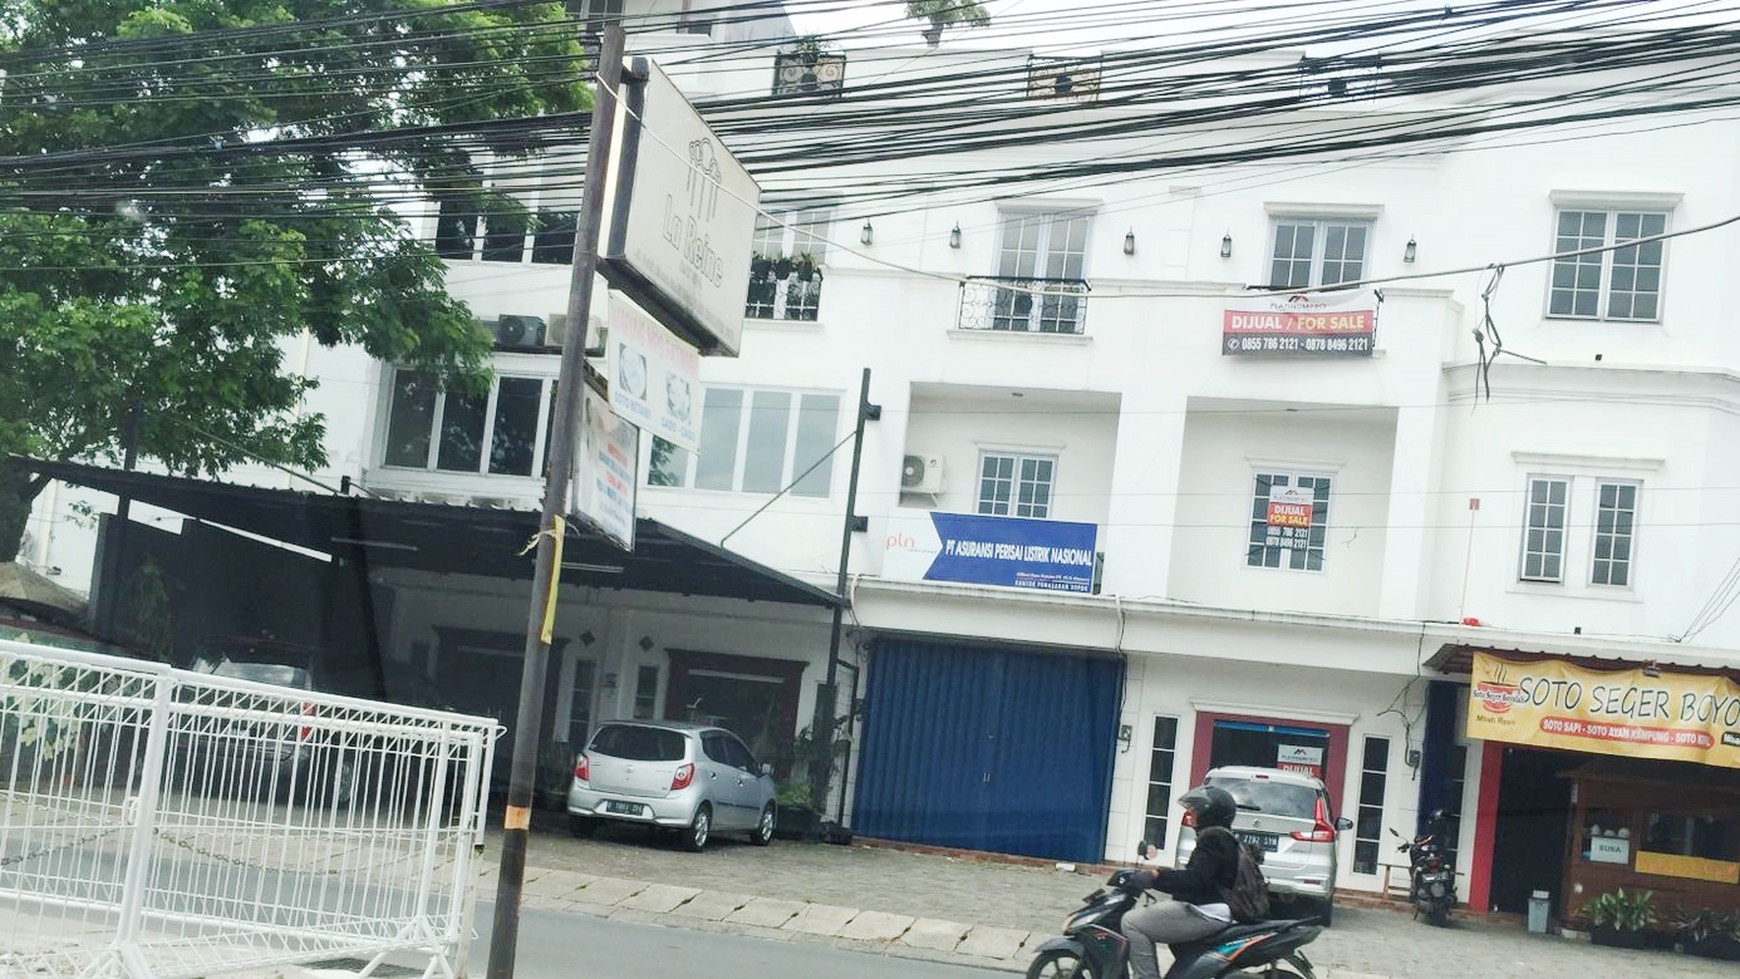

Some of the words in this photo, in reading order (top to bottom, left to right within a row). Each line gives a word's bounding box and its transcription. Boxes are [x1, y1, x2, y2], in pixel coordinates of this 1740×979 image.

[663, 193, 683, 251] La
[684, 214, 723, 289] Reine
[1231, 315, 1283, 330] DIJUAL
[1286, 317, 1293, 330] /
[1297, 316, 1326, 330] FOR
[1329, 315, 1365, 330] SALE
[1279, 337, 1299, 351] 2121
[1348, 338, 1368, 351] 2121
[1274, 505, 1305, 516] DIJUAL
[1270, 514, 1287, 524] FOR
[1288, 516, 1309, 526] SALE
[886, 532, 916, 550] pln
[945, 539, 956, 556] PT
[956, 541, 994, 559] ASURANSI
[994, 544, 1024, 561] PERISAI
[1024, 547, 1049, 563] LISTRIK
[1050, 549, 1092, 566] NASIONAL
[1519, 677, 1582, 710] SOTO
[1590, 686, 1671, 720] SEGER
[1543, 719, 1562, 731] SOTO
[1564, 721, 1582, 733] SAPI
[1586, 723, 1606, 736] SOTO
[1608, 725, 1630, 739] AYAM
[1675, 732, 1696, 744] SOTO
[1283, 764, 1314, 776] DIJUAL
